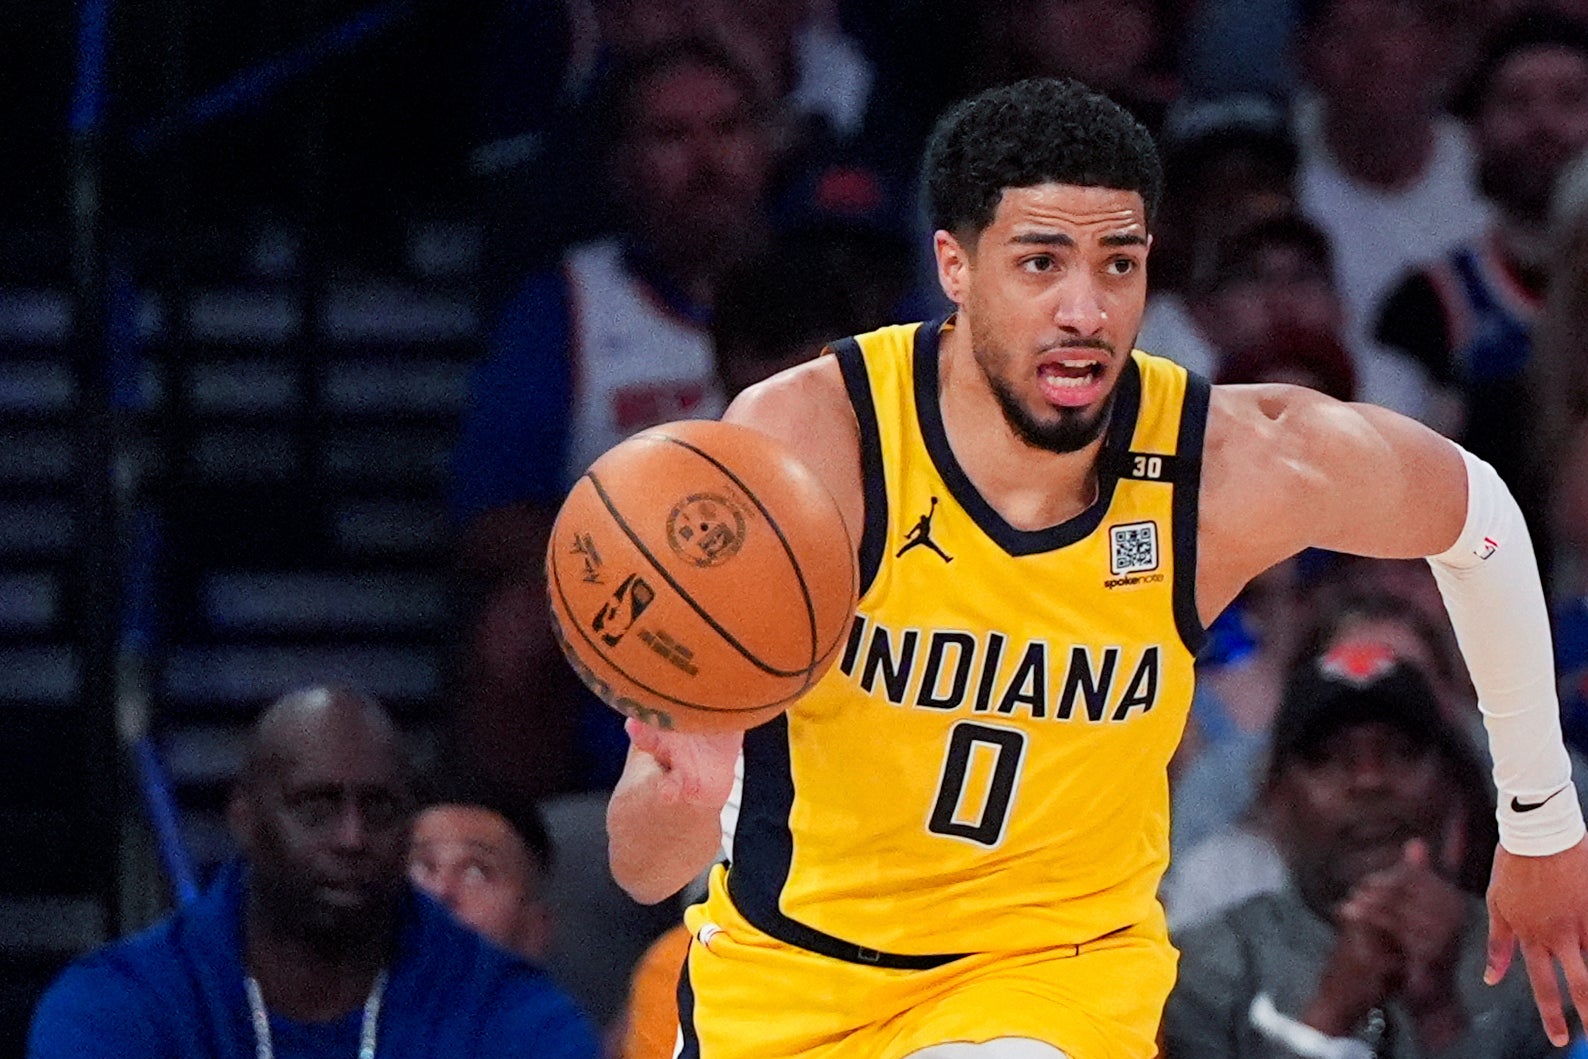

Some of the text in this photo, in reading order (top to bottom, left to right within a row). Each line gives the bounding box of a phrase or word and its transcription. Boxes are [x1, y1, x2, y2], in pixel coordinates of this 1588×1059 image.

[1132, 456, 1162, 478] 30
[839, 613, 1160, 722] INDIANA
[926, 719, 1028, 849] 0
